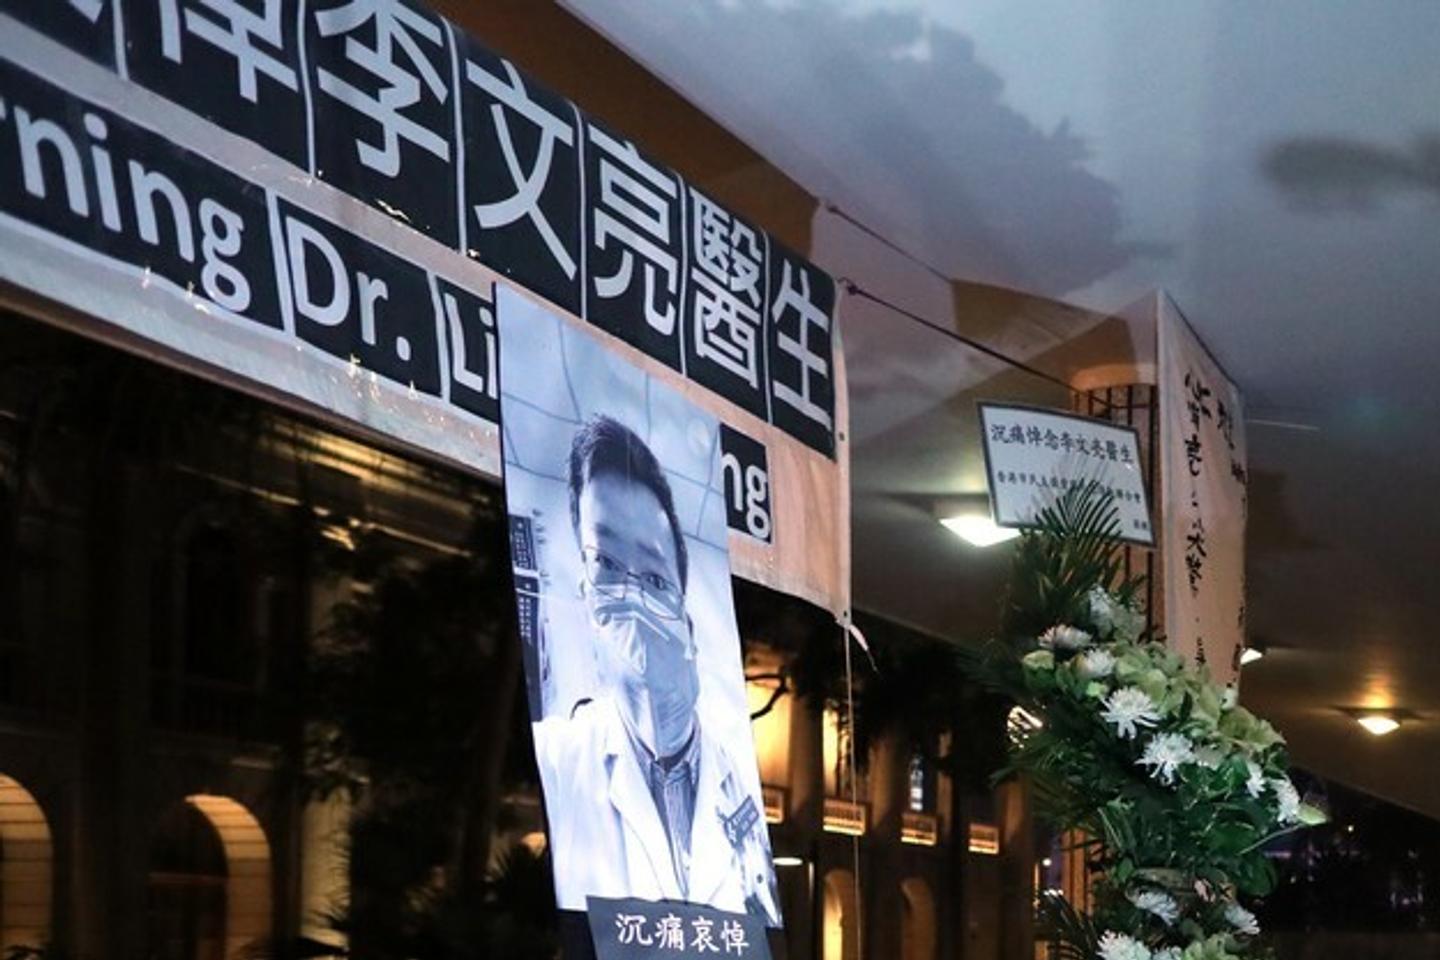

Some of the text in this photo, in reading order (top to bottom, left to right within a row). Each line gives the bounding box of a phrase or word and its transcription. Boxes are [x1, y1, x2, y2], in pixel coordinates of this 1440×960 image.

[0, 96, 251, 314] ning
[287, 216, 411, 361] Dr.
[444, 291, 498, 400] Li
[68, 0, 832, 431] 李文亮醫生
[615, 912, 749, 957] 沉痛哀悼
